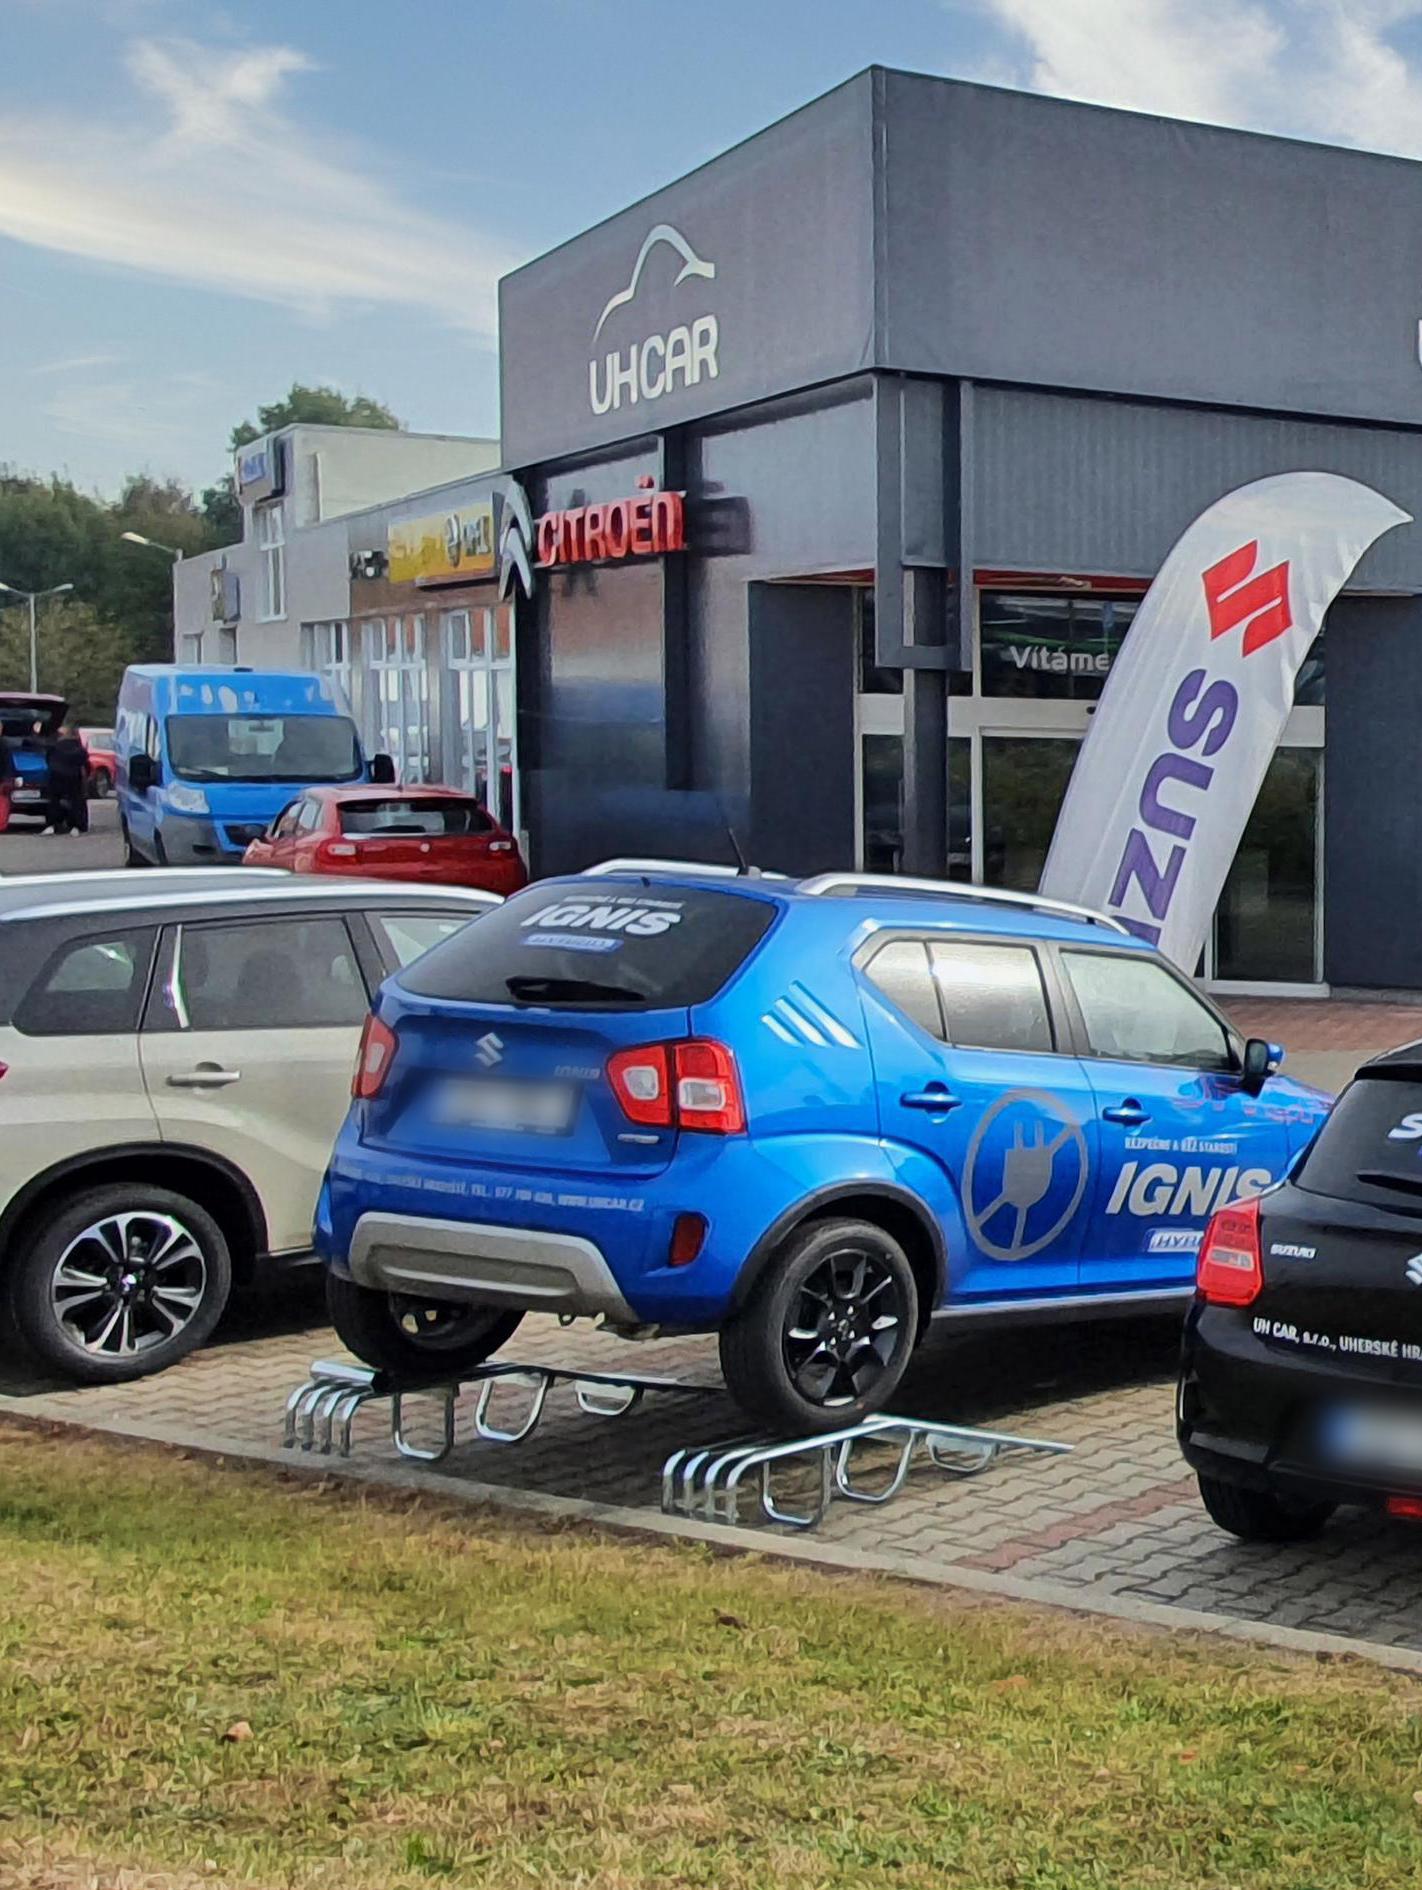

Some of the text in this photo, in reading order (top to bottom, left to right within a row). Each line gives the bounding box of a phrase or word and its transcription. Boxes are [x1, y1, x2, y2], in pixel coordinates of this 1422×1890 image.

[520, 904, 682, 936] IGNIS
[1105, 1160, 1272, 1216] IGNIS
[1253, 1317, 1270, 1335] UH
[1273, 1321, 1300, 1343] CAR,
[1339, 1336, 1398, 1357] UHERSKÉ
